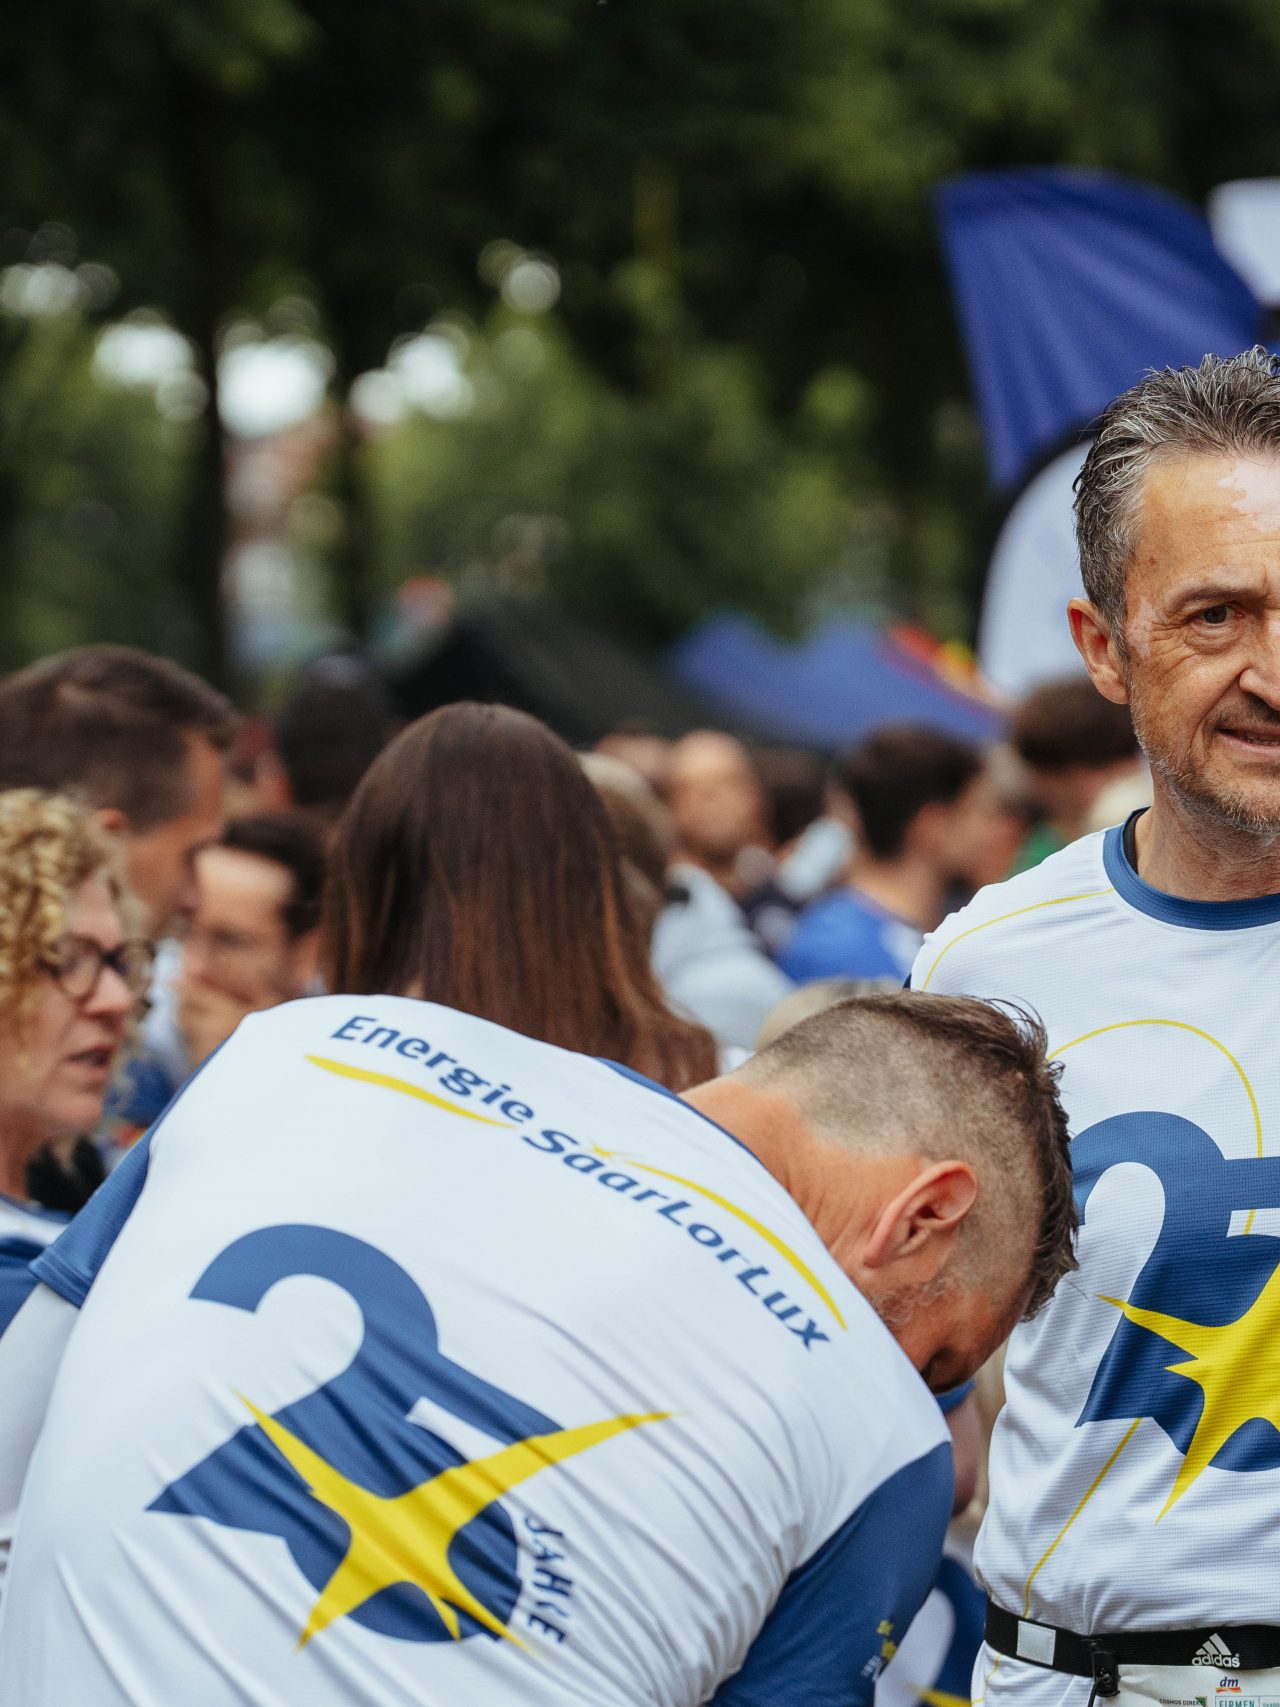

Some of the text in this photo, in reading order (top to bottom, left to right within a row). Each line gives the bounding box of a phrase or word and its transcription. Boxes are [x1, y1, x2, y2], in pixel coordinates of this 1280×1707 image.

[331, 1015, 831, 1352] Energie SaarLorLux
[147, 1223, 566, 1643] 25
[1191, 1653, 1240, 1668] adidas
[1220, 1677, 1239, 1687] dm
